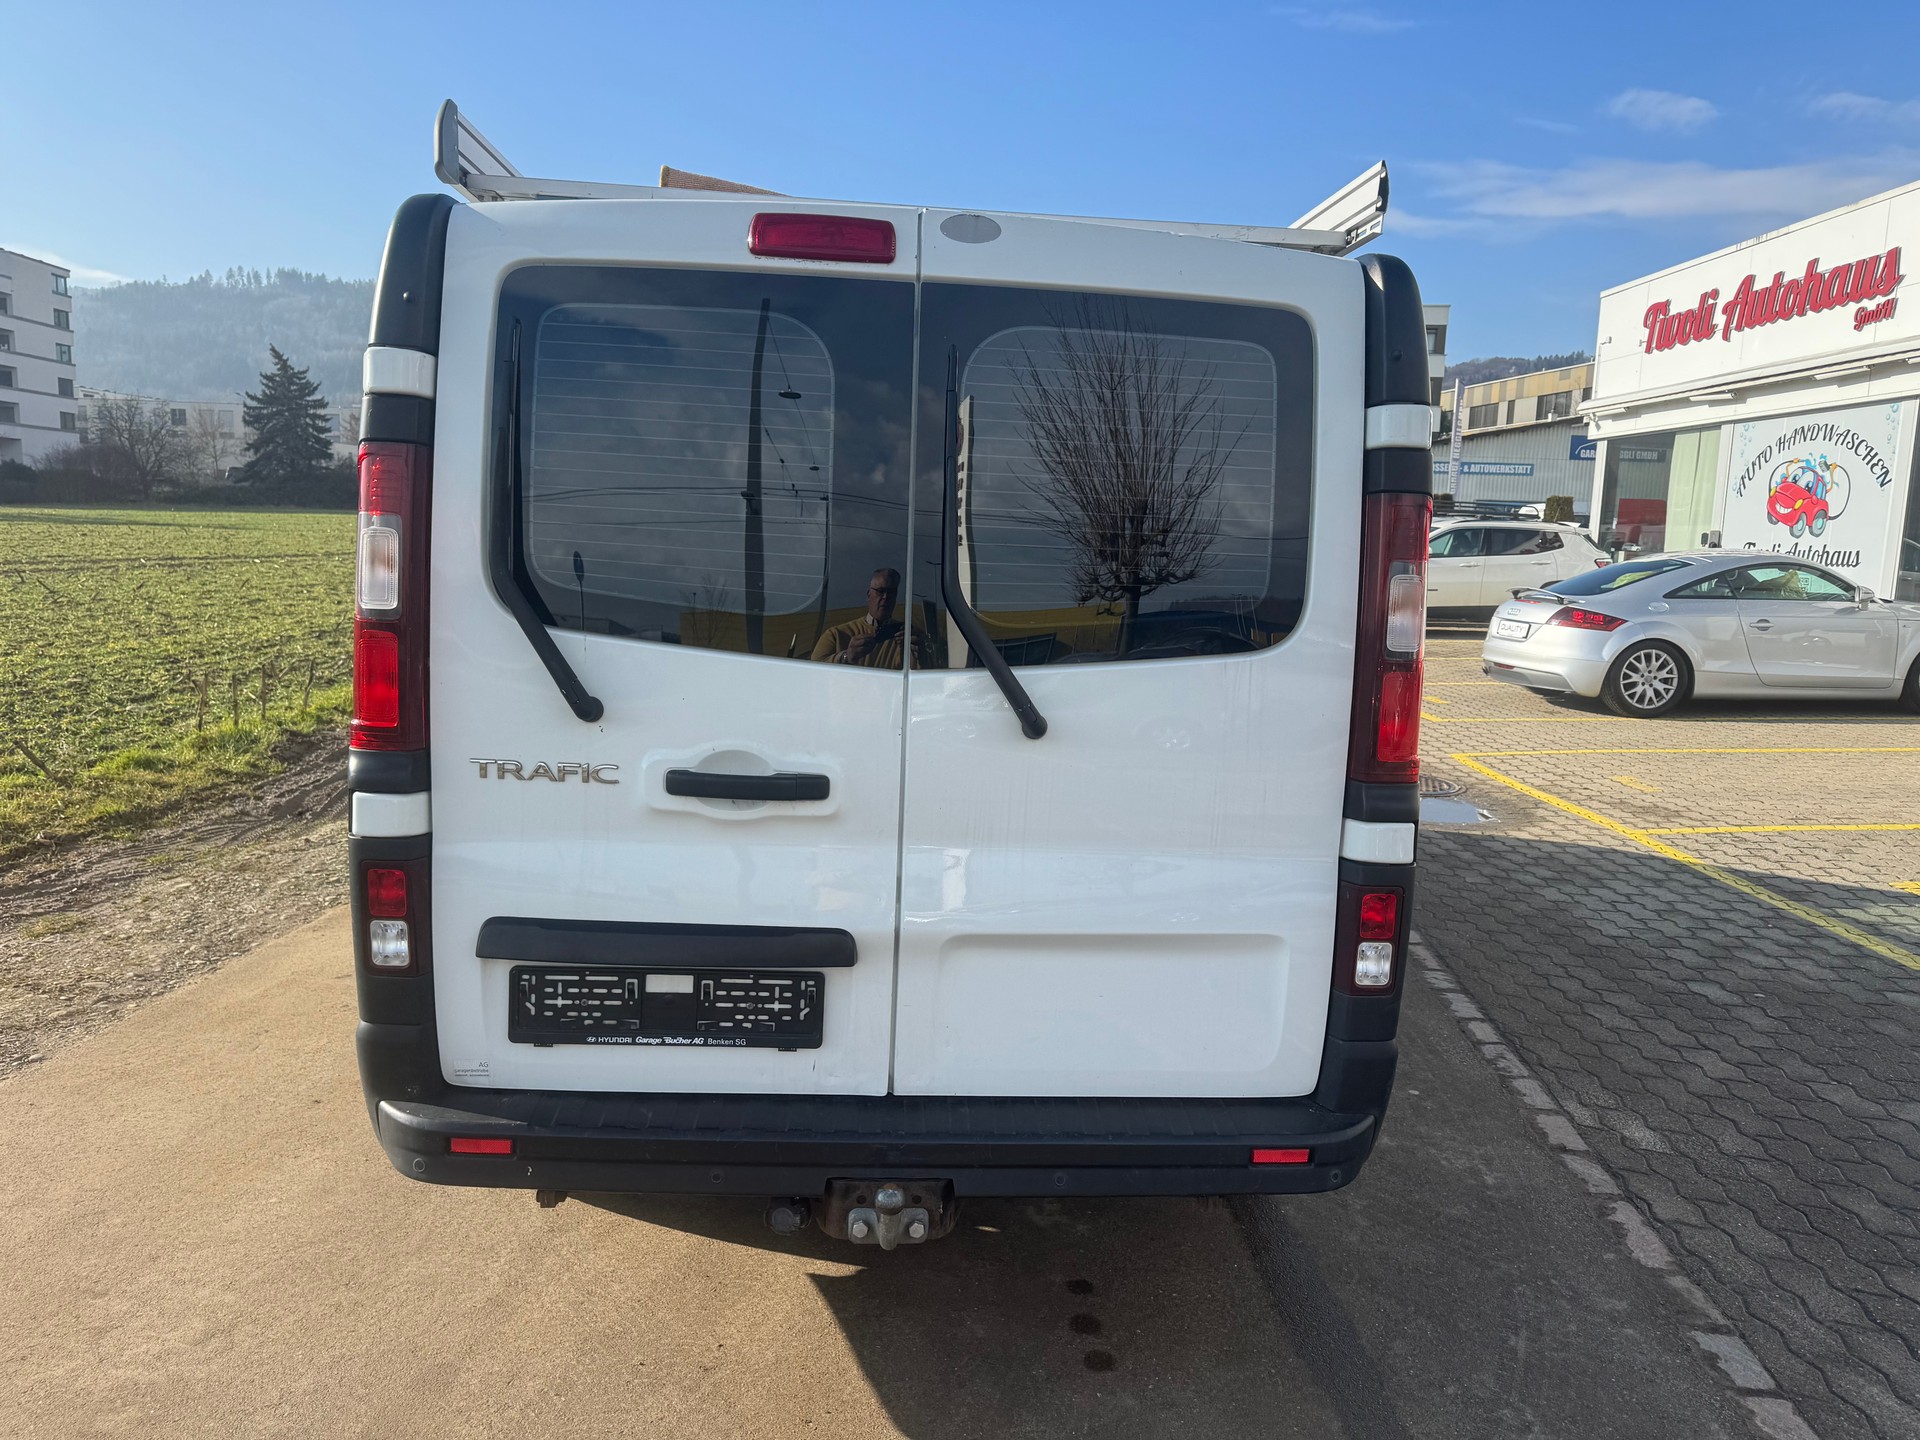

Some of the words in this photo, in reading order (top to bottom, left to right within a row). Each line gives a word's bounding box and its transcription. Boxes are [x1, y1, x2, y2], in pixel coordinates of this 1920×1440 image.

[1644, 288, 1719, 354] Tivoli
[1722, 246, 1905, 342] Autohaus
[1853, 298, 1898, 332] GmbH
[1470, 464, 1532, 474] AUTOWERKSTATT
[1736, 445, 1773, 497] AUTO
[1775, 423, 1892, 489] HANDWASCHEN
[1784, 541, 1862, 568] Autohaus
[469, 757, 620, 784] TRAFIC
[635, 1036, 663, 1045] Garage
[708, 1038, 734, 1046] Benken
[735, 1038, 747, 1046] SG
